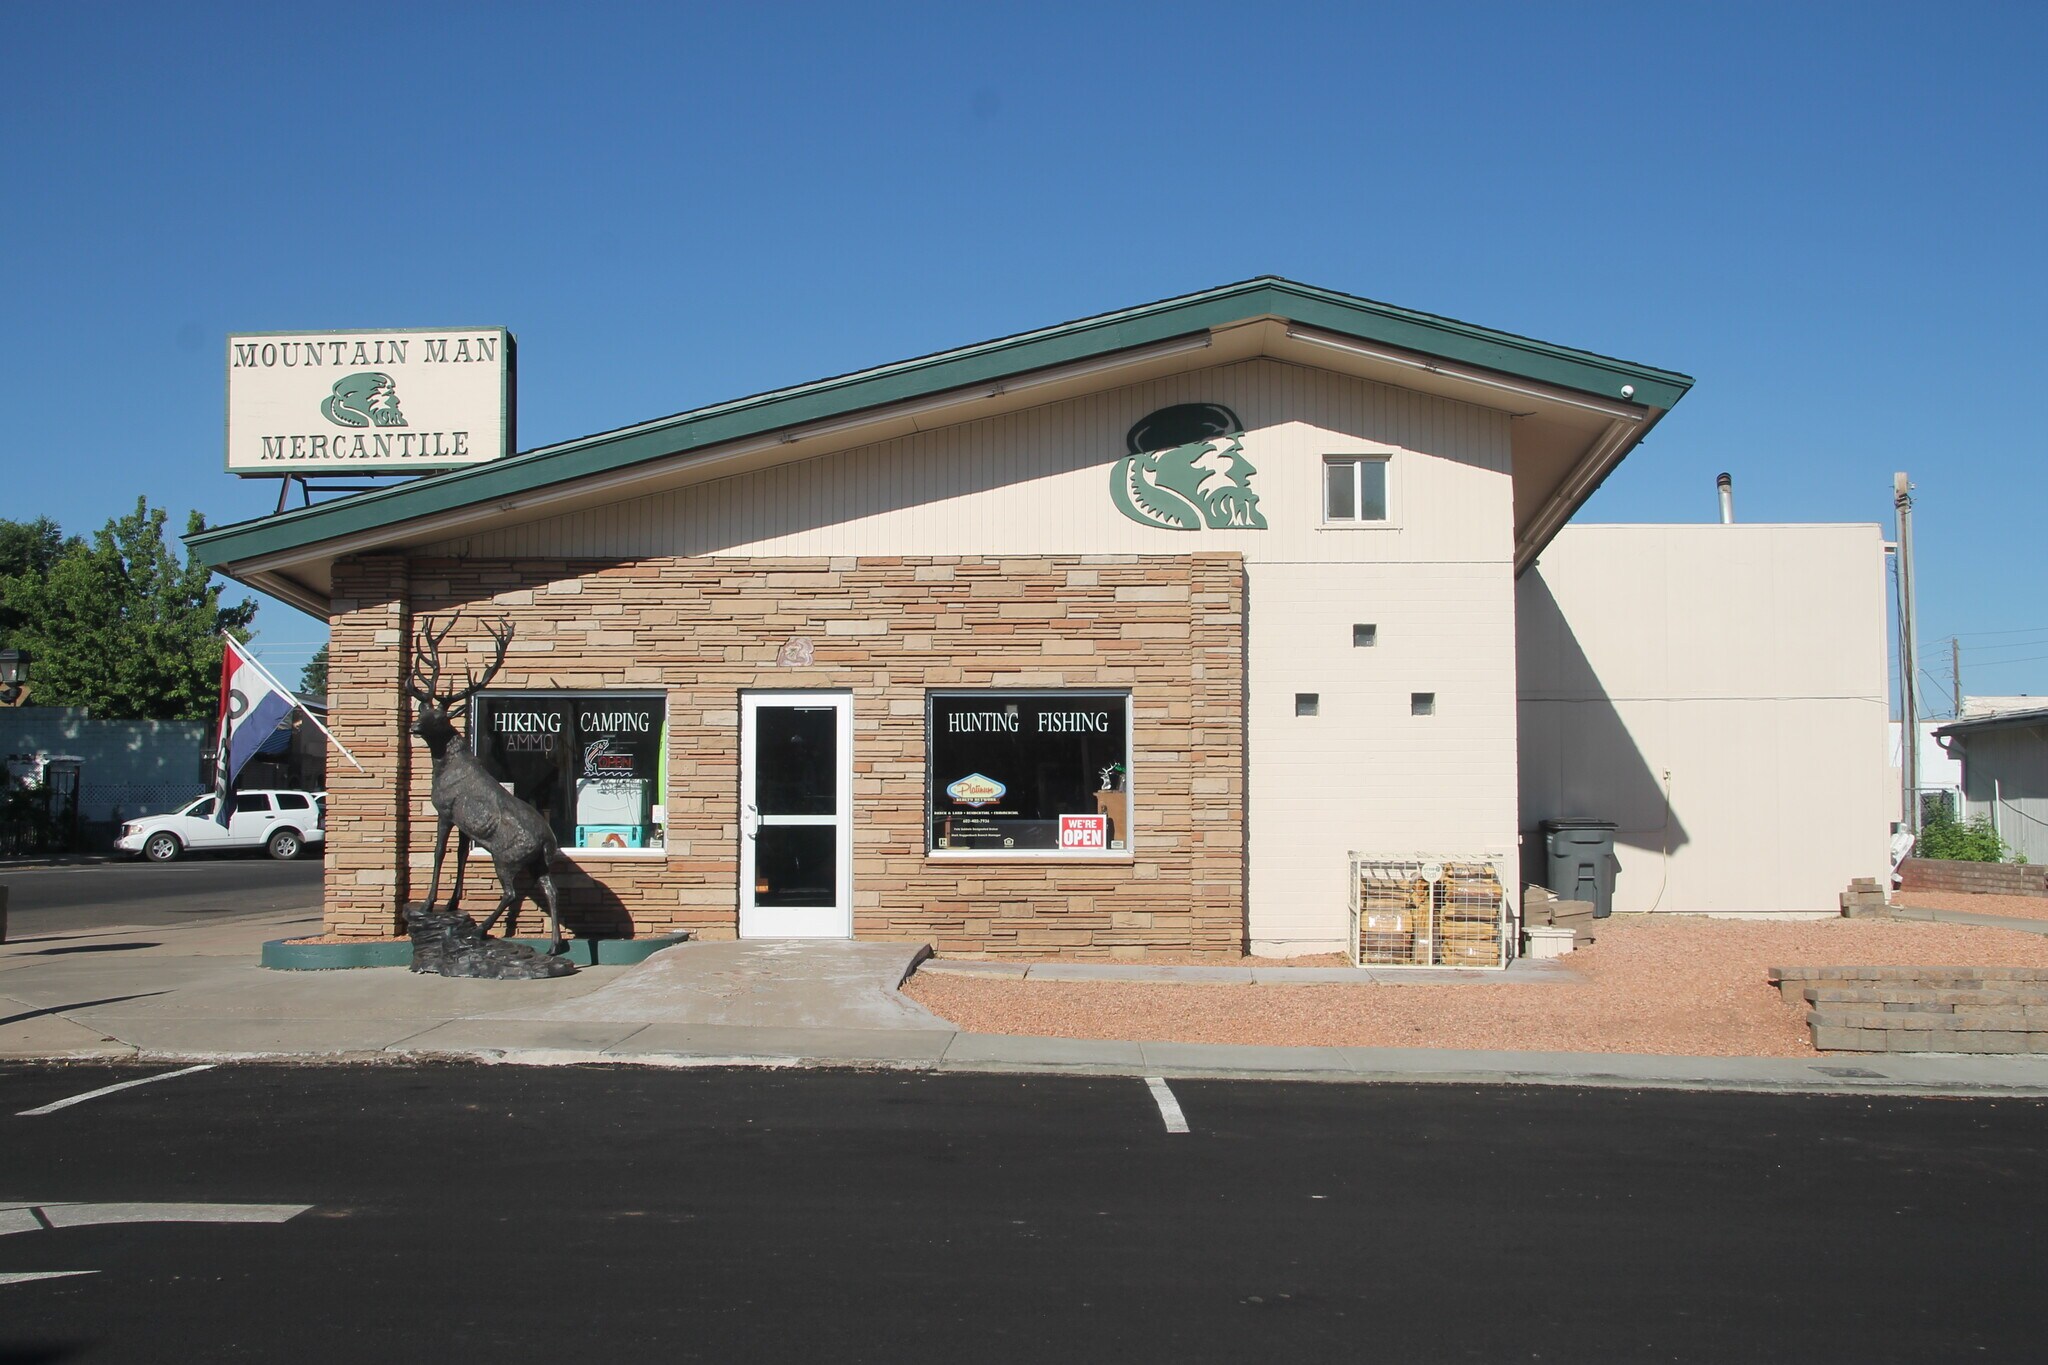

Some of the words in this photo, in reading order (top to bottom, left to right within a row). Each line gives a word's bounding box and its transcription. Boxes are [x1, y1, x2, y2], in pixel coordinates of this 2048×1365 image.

[233, 340, 410, 368] MOUNTAIN
[424, 337, 498, 363] MAN
[260, 431, 470, 460] MERCANTILE
[493, 712, 562, 733] HIKING
[580, 711, 650, 733] CAMPING
[948, 712, 1020, 732] HUNTING
[1037, 711, 1109, 732] FISHING
[506, 733, 554, 752] AMMO
[598, 756, 633, 768] OPEN
[956, 782, 994, 797] Platinum
[1067, 820, 1098, 829] WE'RE
[1063, 829, 1102, 846] OPEN
